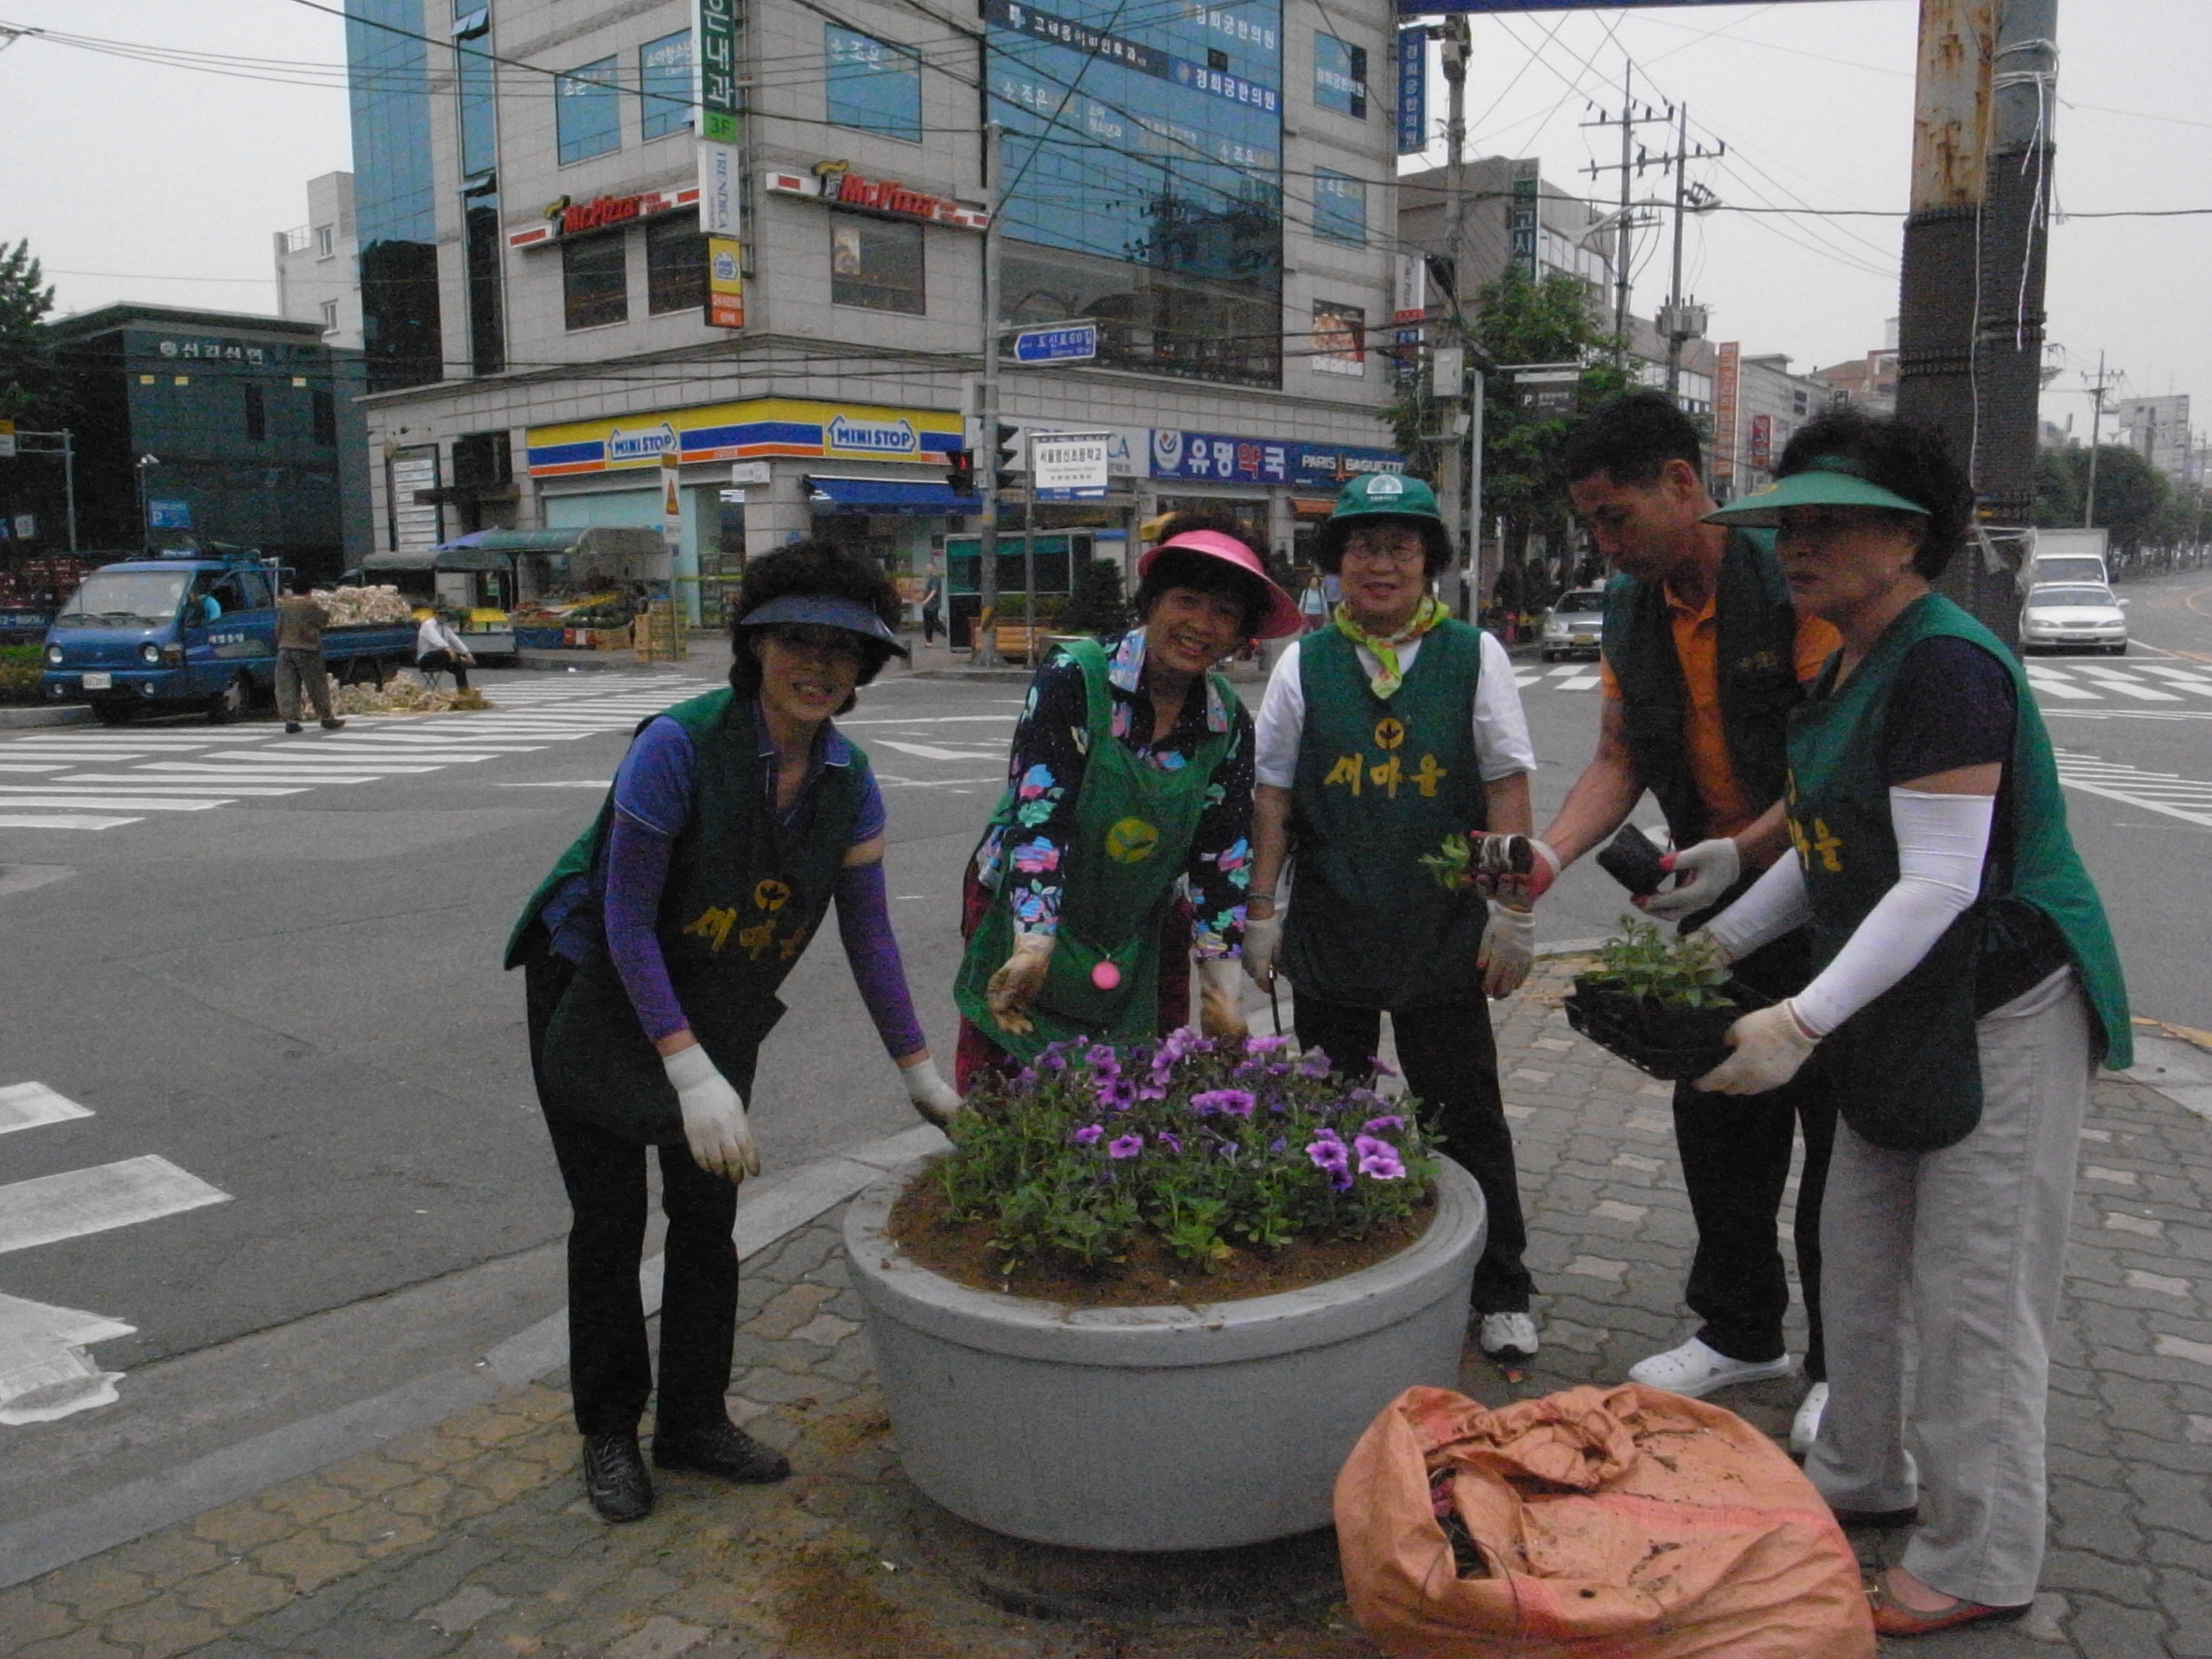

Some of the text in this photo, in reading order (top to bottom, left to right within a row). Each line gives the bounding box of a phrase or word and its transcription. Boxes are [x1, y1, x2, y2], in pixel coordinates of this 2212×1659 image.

[1196, 68, 1275, 110] 경희궁한의원
[708, 116, 731, 135] 3F
[716, 150, 729, 229] TRENDICA
[1187, 438, 1286, 481] 유명약국
[1301, 454, 1336, 470] PARIS
[1324, 752, 1449, 799] 새마을
[1787, 817, 1845, 872] 마을
